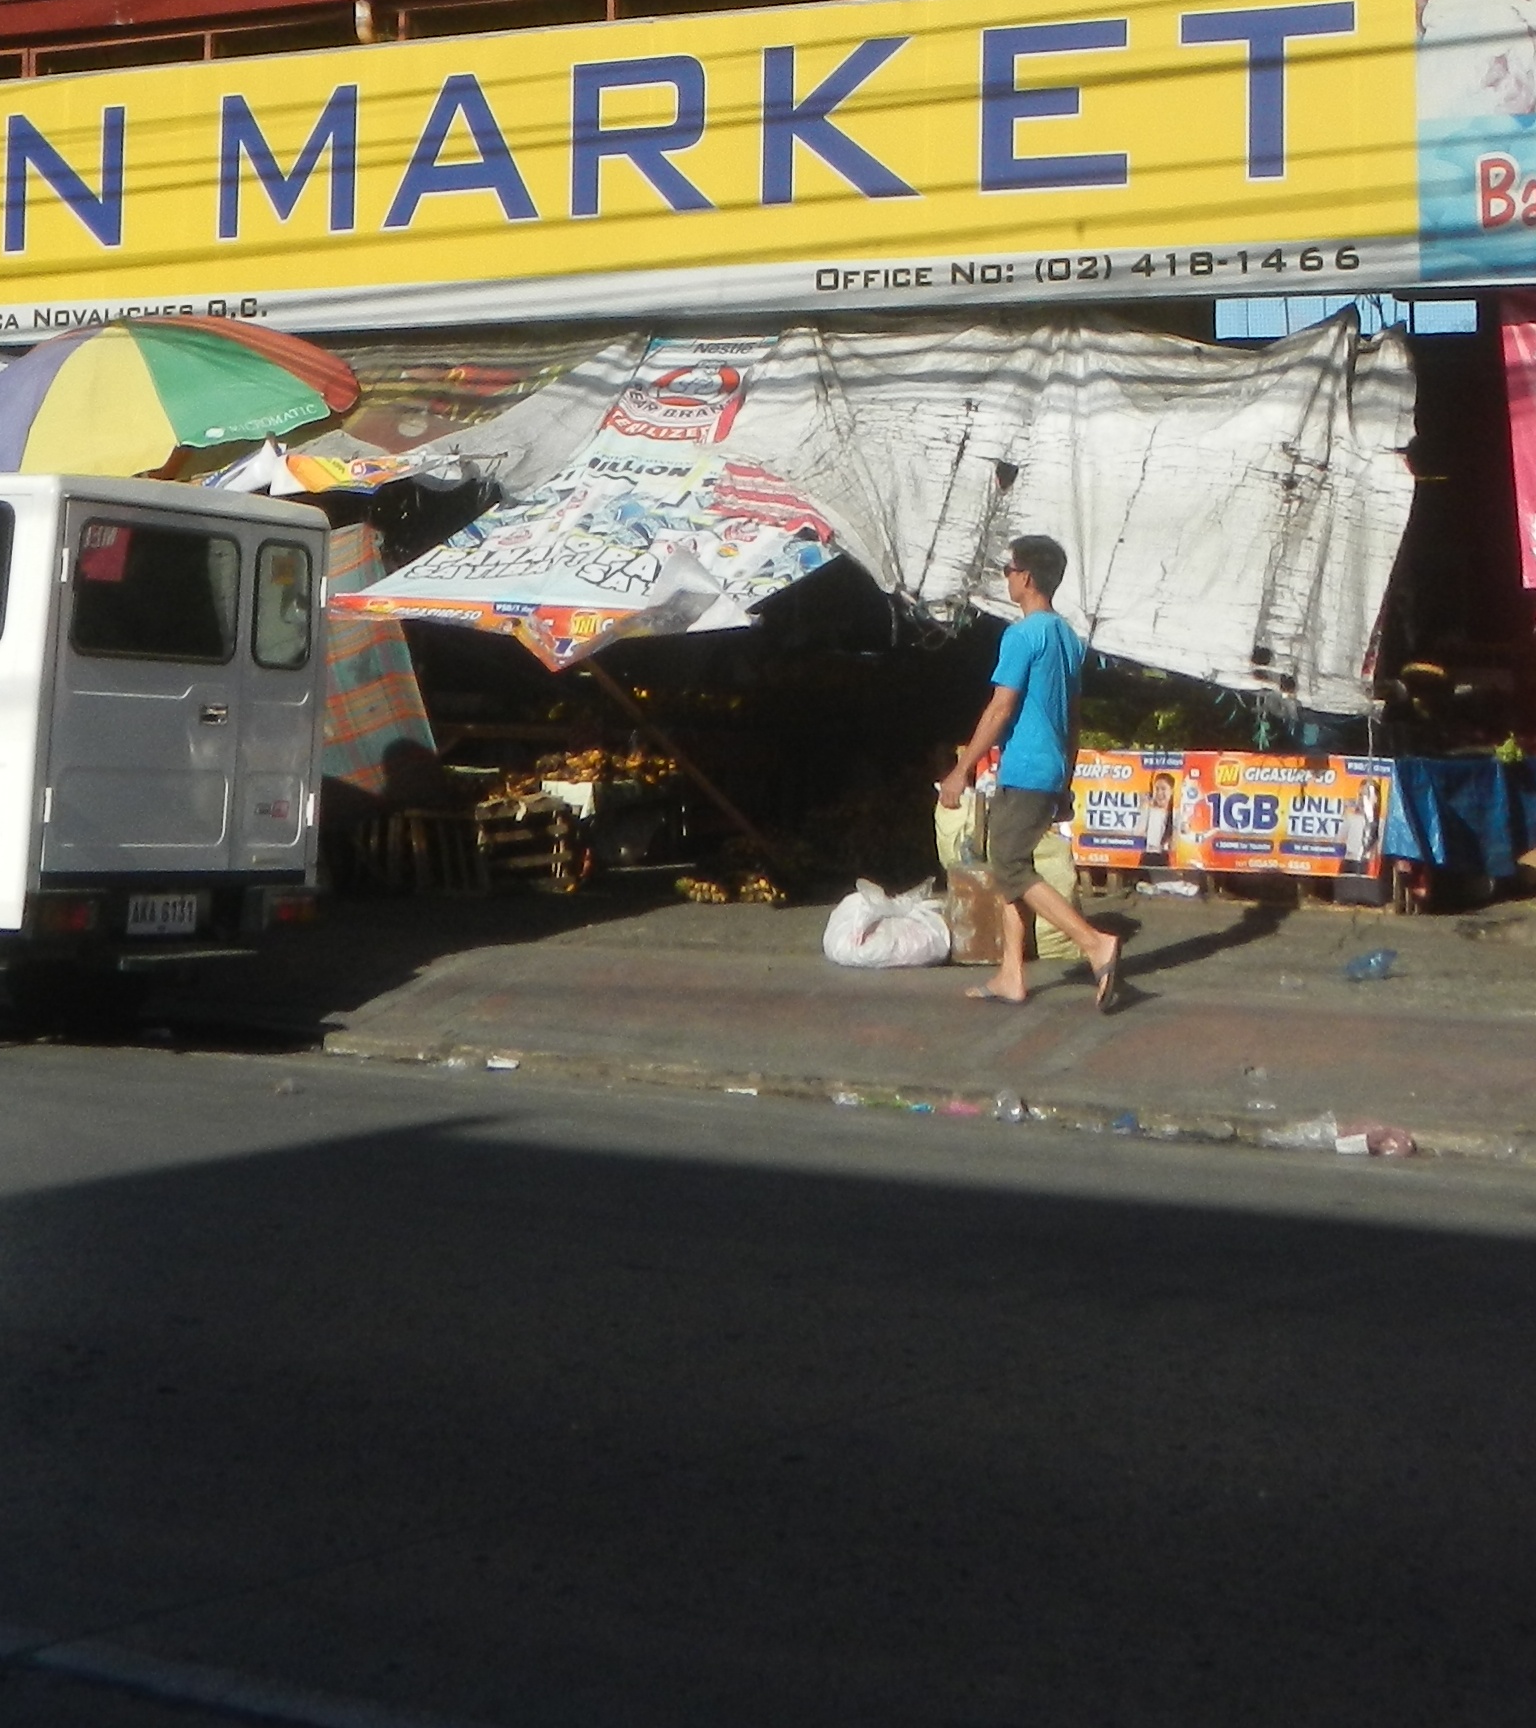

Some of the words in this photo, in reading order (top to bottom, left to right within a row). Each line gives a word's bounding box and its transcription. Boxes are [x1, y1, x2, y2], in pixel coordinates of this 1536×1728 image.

[216, 0, 1356, 240] MARKET
[816, 265, 932, 290] OFFICE
[1034, 255, 1113, 283] (02)
[1131, 246, 1361, 277] 418-1466
[207, 298, 268, 318] Q.C.
[663, 400, 732, 419] BRAN
[1089, 790, 1139, 808] UNLI
[1292, 795, 1343, 816] UNLI
[1086, 809, 1142, 828] TEXT
[1206, 792, 1280, 832] 1GB
[1288, 815, 1344, 835] TEXT
